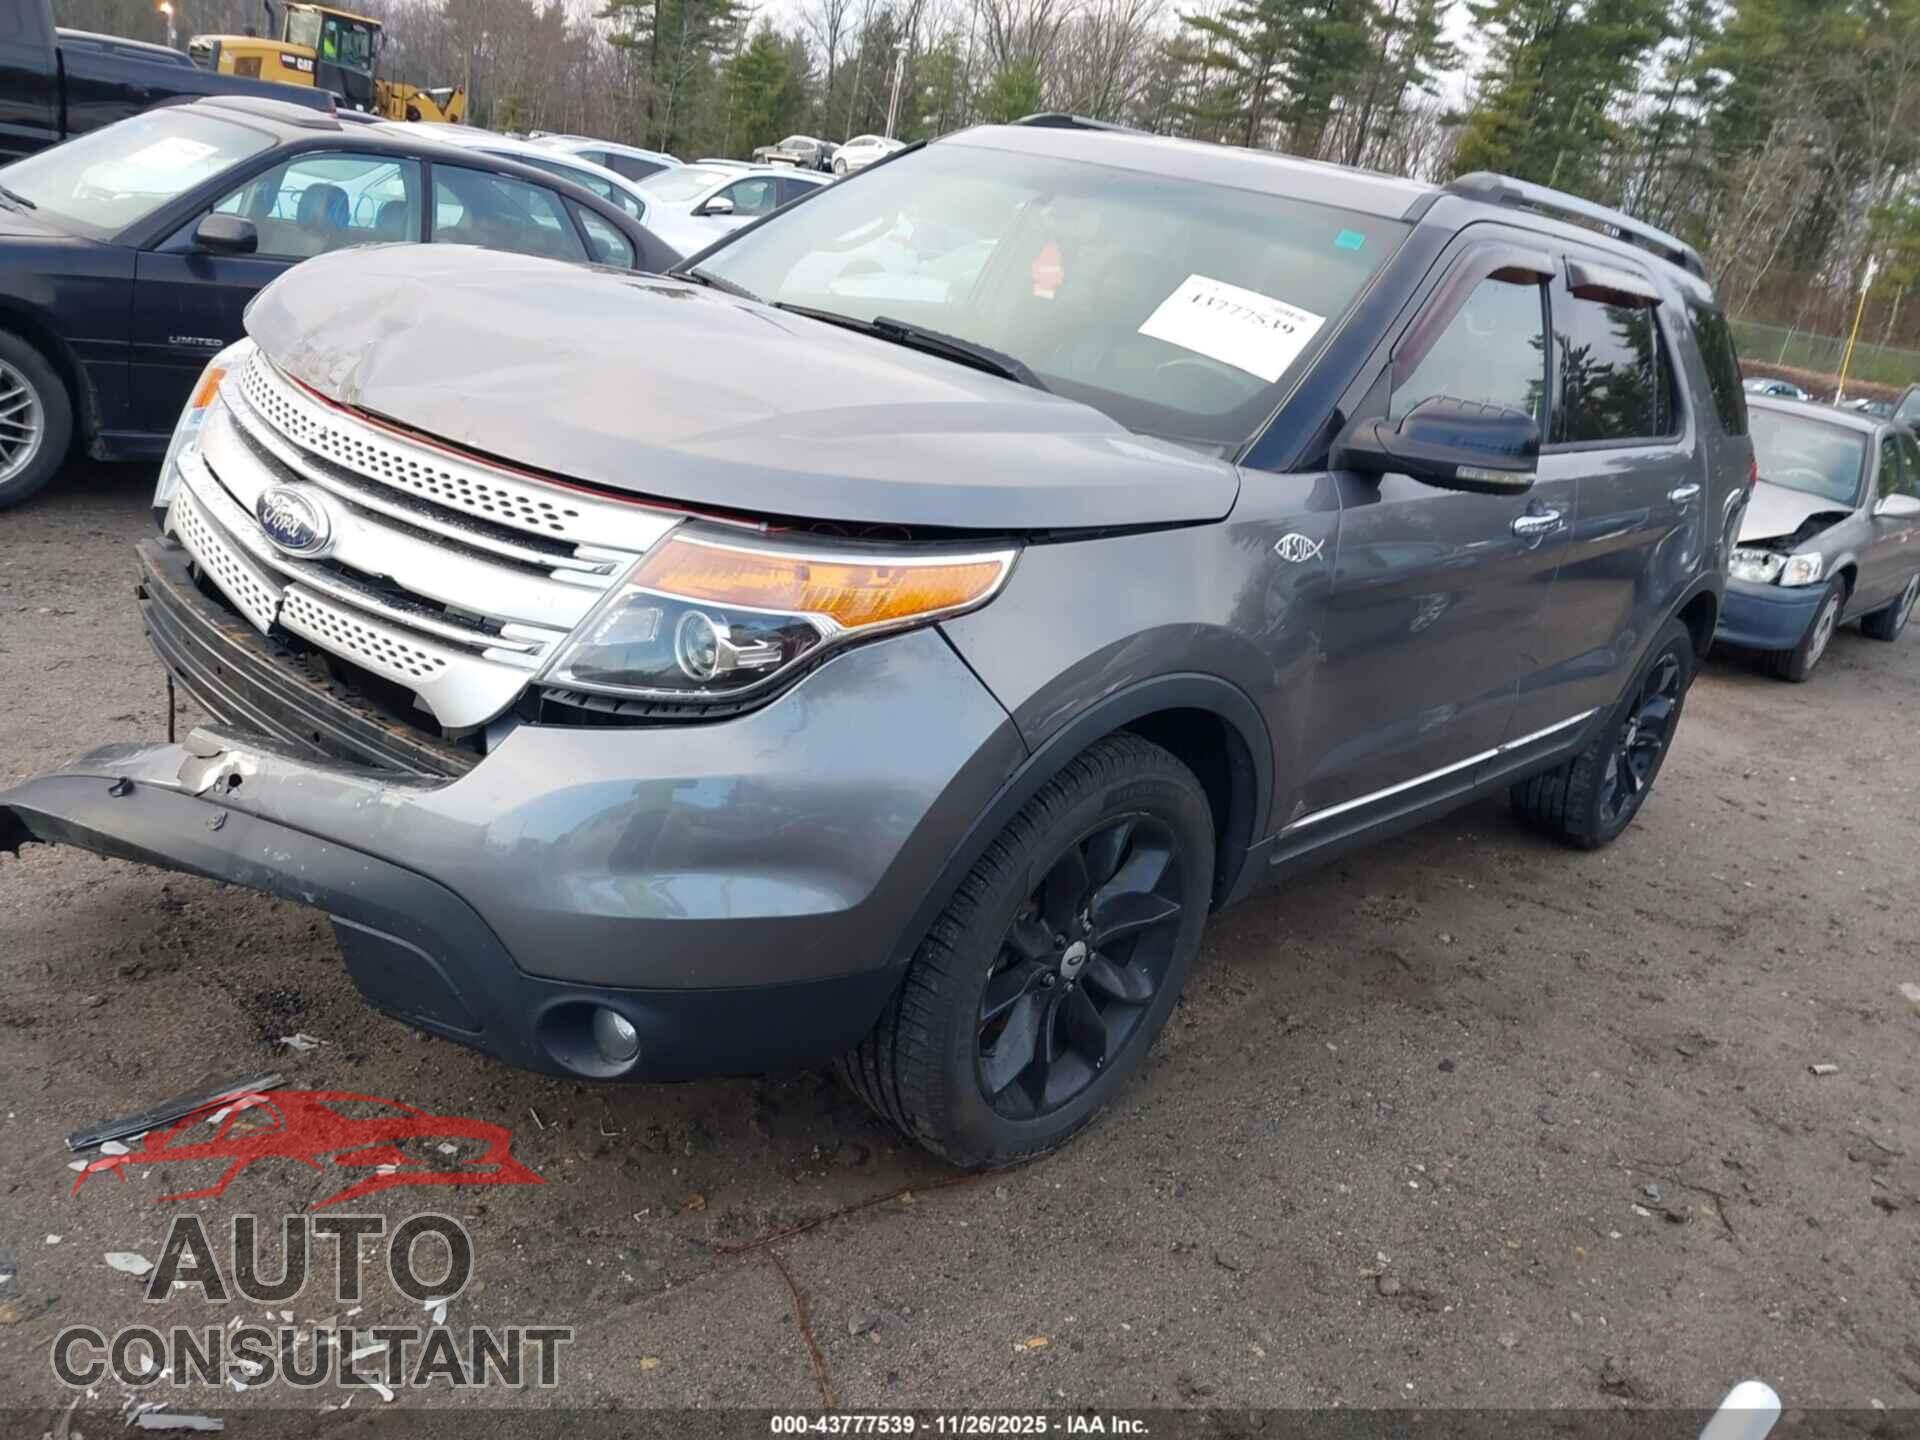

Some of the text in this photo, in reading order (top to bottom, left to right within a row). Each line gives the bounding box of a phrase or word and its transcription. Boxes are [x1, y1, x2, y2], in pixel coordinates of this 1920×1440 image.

[296, 57, 314, 72] CAT
[168, 335, 223, 346] LIMITED
[262, 494, 304, 538] Ford
